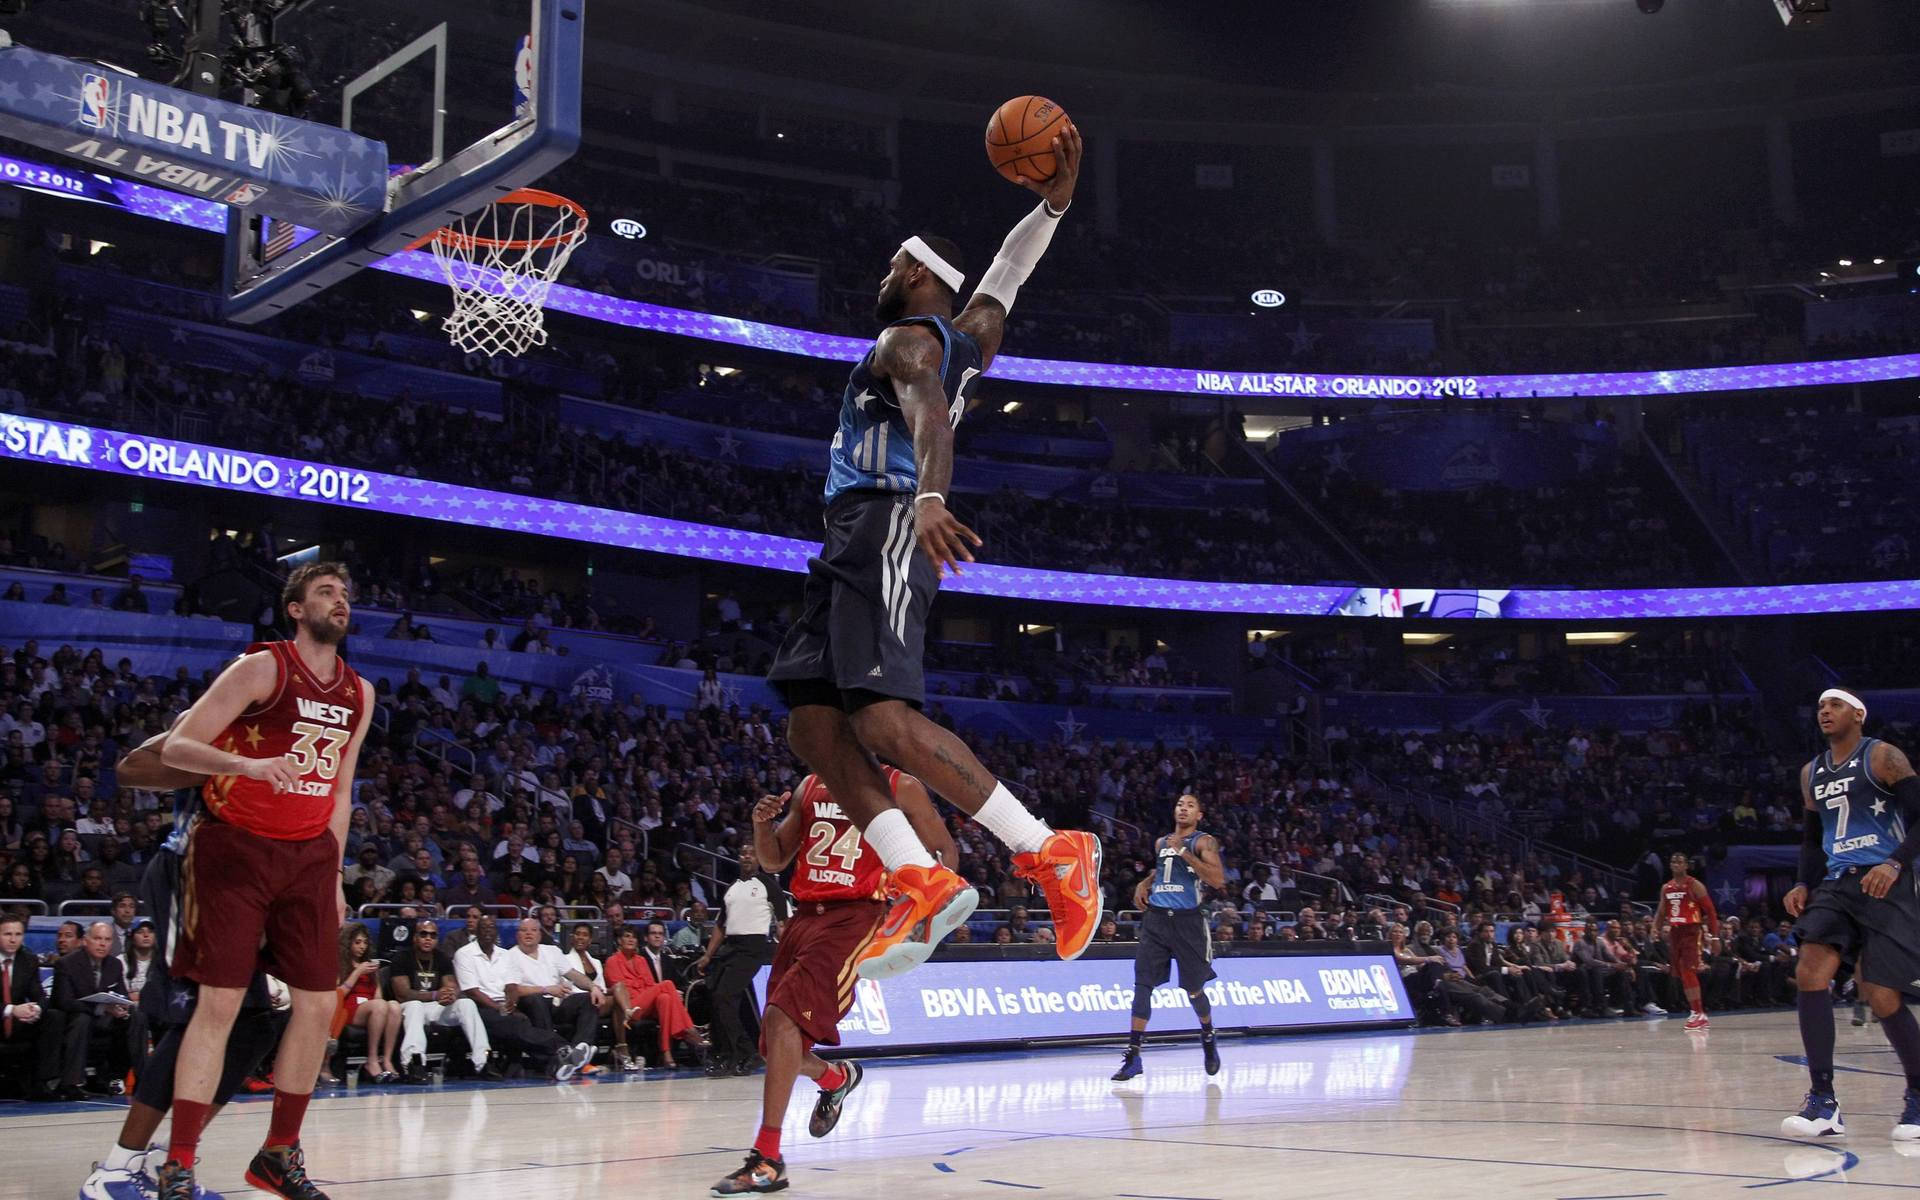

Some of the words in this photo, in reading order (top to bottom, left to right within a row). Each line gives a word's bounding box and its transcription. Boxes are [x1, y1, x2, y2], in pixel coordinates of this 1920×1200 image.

[128, 93, 212, 154] NBA
[219, 121, 272, 169] TV
[65, 139, 128, 167] TV
[0, 161, 21, 178] O
[38, 170, 84, 192] 2012
[134, 154, 224, 193] NBA
[613, 220, 645, 238] KIA
[1253, 291, 1283, 305] KIA
[1196, 373, 1234, 392] NBA
[1238, 375, 1318, 394] ALL-STAR
[1332, 378, 1421, 396] ORLANDO
[1432, 379, 1478, 397] 2012
[119, 439, 280, 489] ORLANDO
[299, 465, 370, 503] 2012
[296, 697, 354, 726] WEST
[284, 721, 352, 780] 33
[1814, 776, 1856, 801] EAST
[813, 801, 851, 821] WE
[1825, 795, 1850, 841] 7
[806, 821, 863, 871] 24
[1163, 856, 1173, 883] 1
[1319, 968, 1378, 996] BBVA
[921, 987, 997, 1017] BBVA
[995, 987, 1020, 1015] is
[1021, 986, 1064, 1014] the
[1066, 983, 1135, 1012] officia
[1150, 987, 1193, 1008] ban
[1204, 981, 1227, 1006] of
[1227, 980, 1265, 1006] the
[1264, 979, 1312, 1005] NBA
[1328, 997, 1360, 1009] Official
[1359, 996, 1386, 1009] Bank
[836, 1016, 867, 1031] ank
